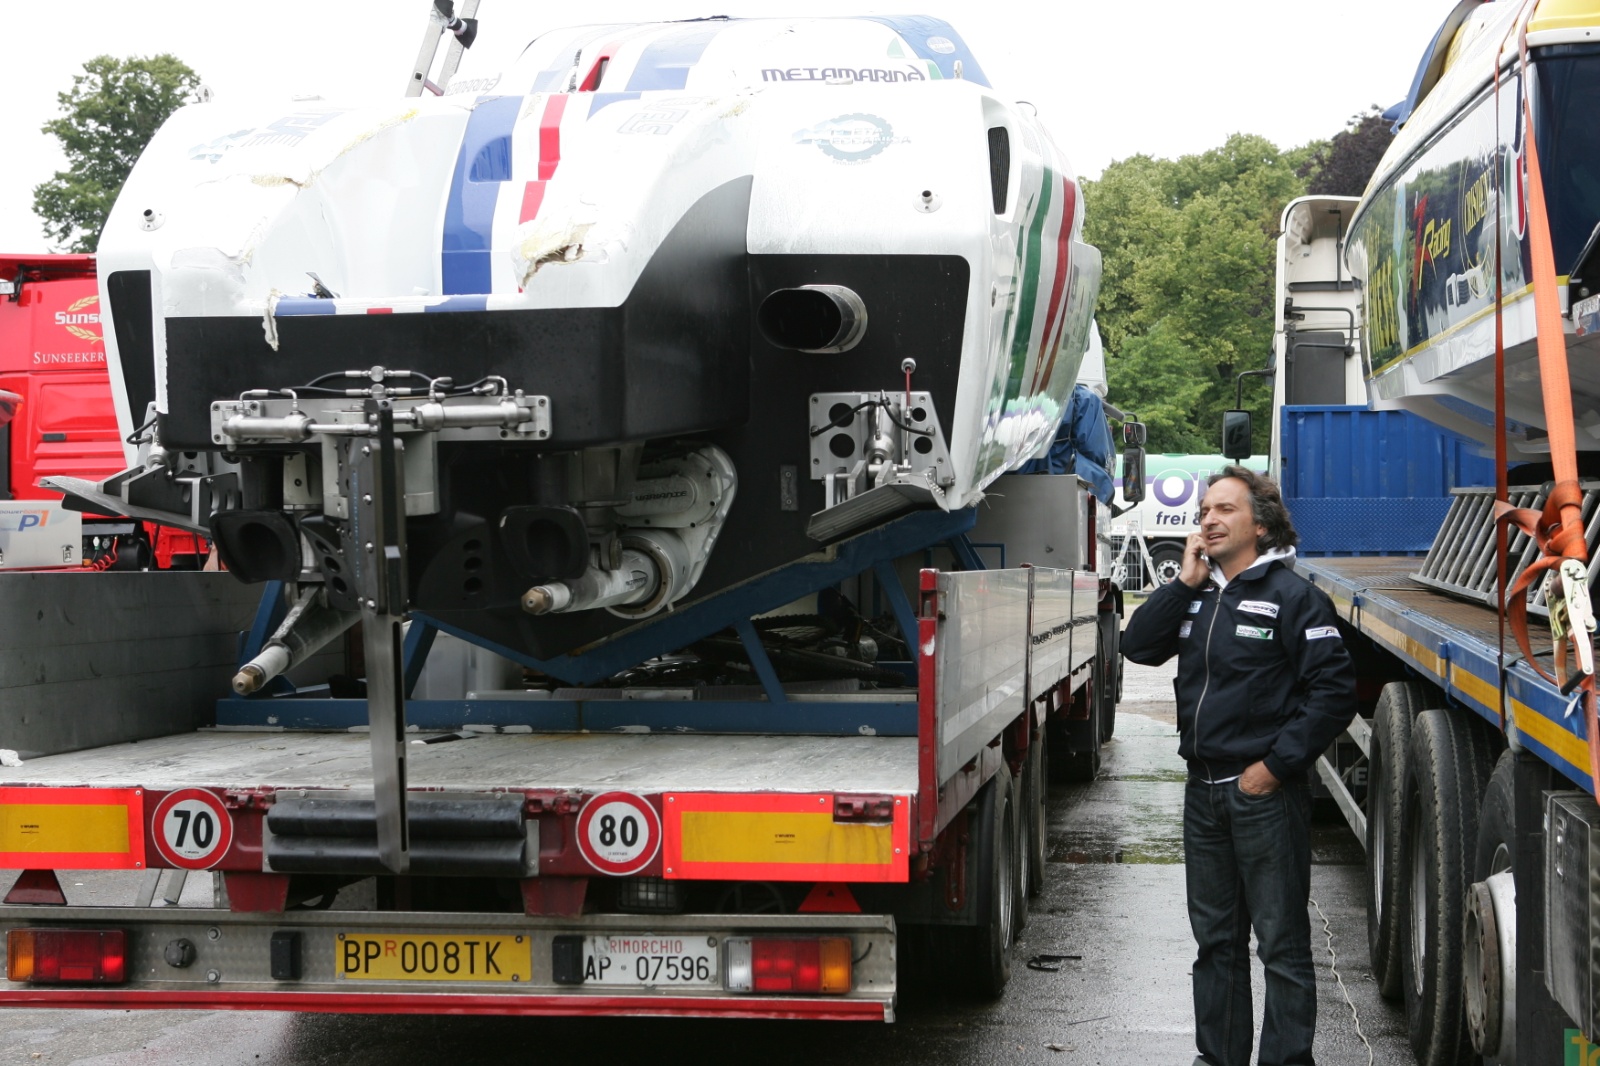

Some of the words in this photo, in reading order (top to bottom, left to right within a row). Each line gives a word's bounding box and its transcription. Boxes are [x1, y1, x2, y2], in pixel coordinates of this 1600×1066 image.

[55, 311, 101, 325] Suns
[1156, 511, 1187, 525] frei
[174, 809, 214, 849] 70
[599, 814, 639, 848] 80
[609, 939, 684, 954] RIMORCHIO
[585, 955, 612, 981] AP
[636, 955, 710, 981] 07596
